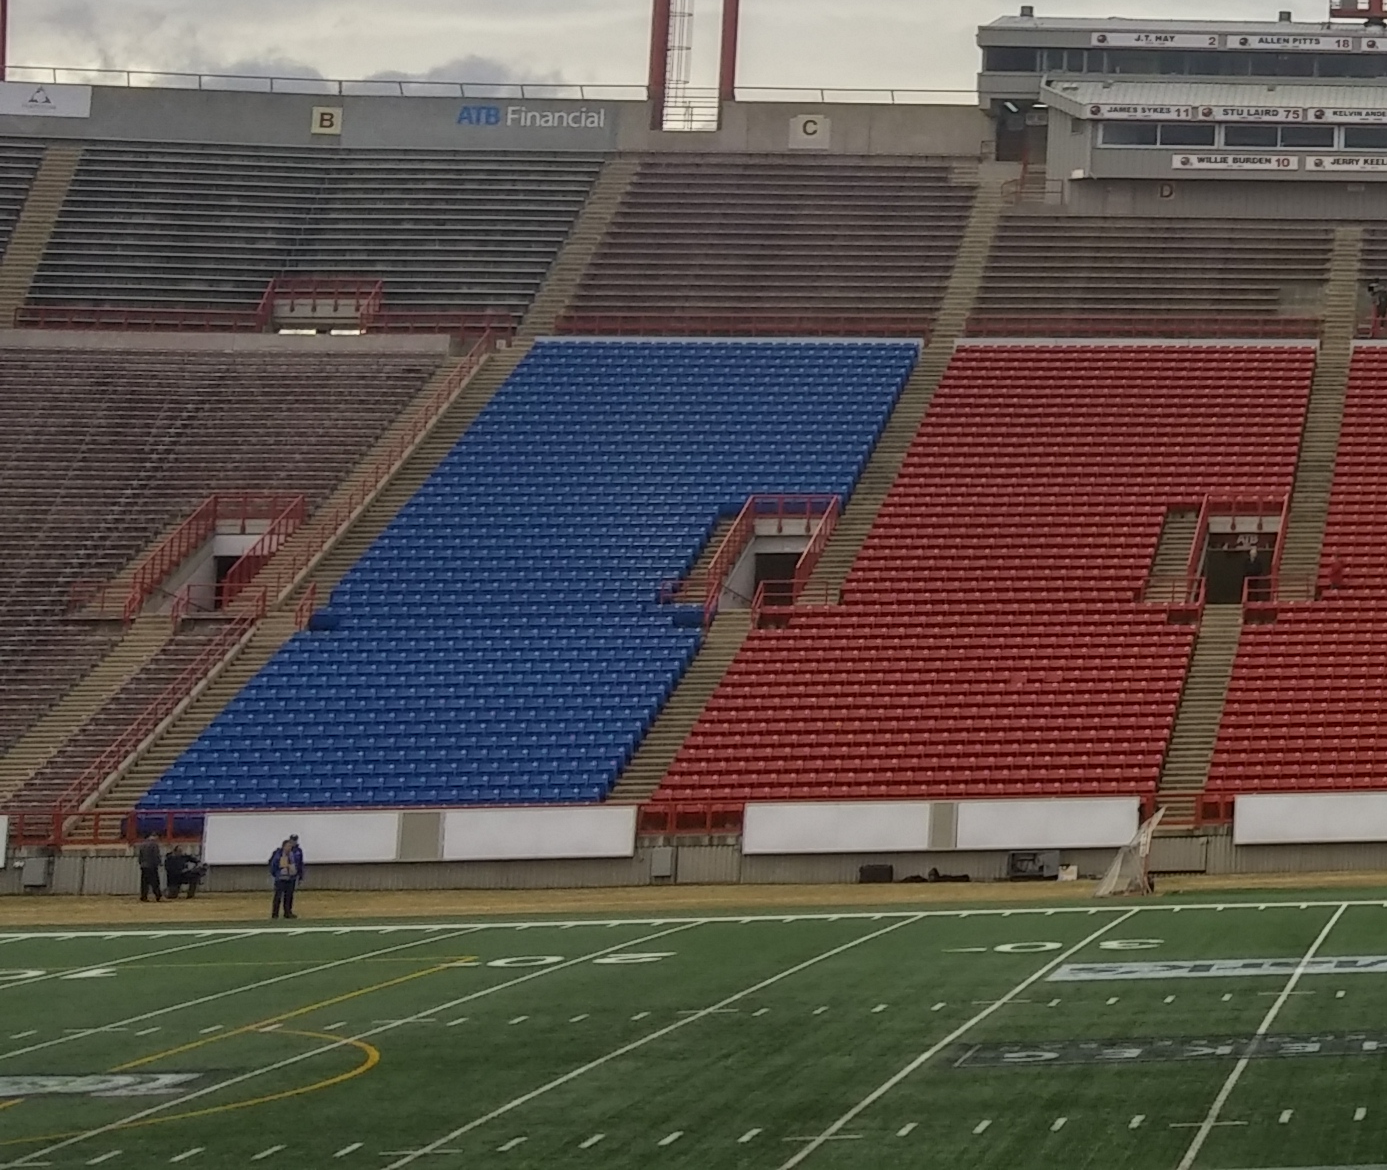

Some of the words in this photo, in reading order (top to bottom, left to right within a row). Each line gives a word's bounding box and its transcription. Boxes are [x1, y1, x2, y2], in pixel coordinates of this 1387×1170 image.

[1208, 36, 1216, 46] 2
[1258, 37, 1289, 45] ALLEN
[1292, 37, 1321, 45] PITTS
[1335, 39, 1349, 48] 18
[457, 106, 500, 125] ATB
[506, 106, 605, 128] Financial
[1175, 108, 1189, 117] 11
[1222, 108, 1244, 116] STU
[1247, 109, 1279, 117] LAIRD
[1284, 109, 1300, 119] 75
[319, 112, 334, 129] B
[802, 119, 819, 136] C
[1196, 156, 1229, 164] WILLIE
[1232, 157, 1272, 165] BURDEN
[1275, 158, 1290, 167] 10
[1330, 158, 1359, 166] JERRY
[1160, 184, 1173, 198] D
[1001, 1045, 1234, 1063] KEG
